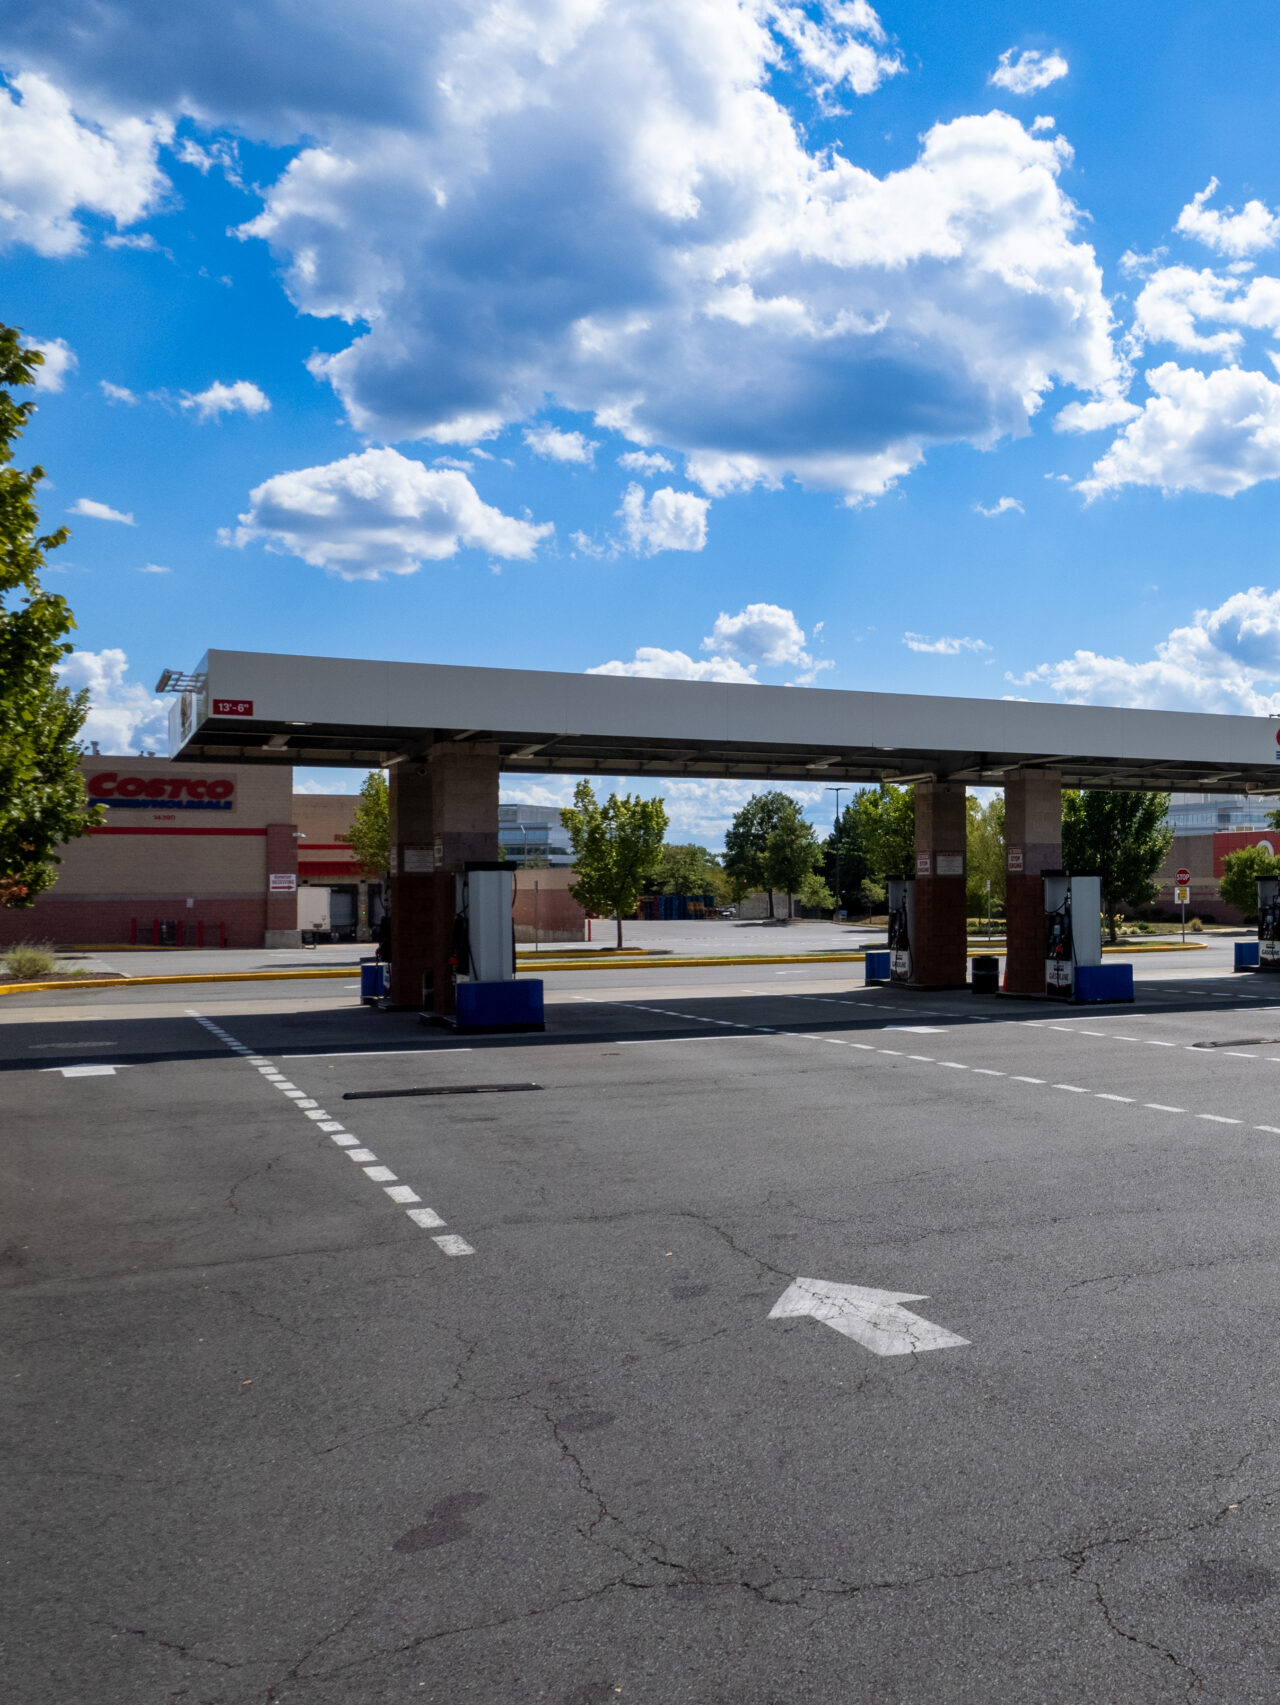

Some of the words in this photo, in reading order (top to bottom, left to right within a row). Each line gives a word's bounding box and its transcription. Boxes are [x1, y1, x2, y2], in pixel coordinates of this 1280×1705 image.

[218, 702, 249, 712] 13'-6"
[88, 772, 234, 800] COSTCO
[1176, 873, 1190, 881] STOP
